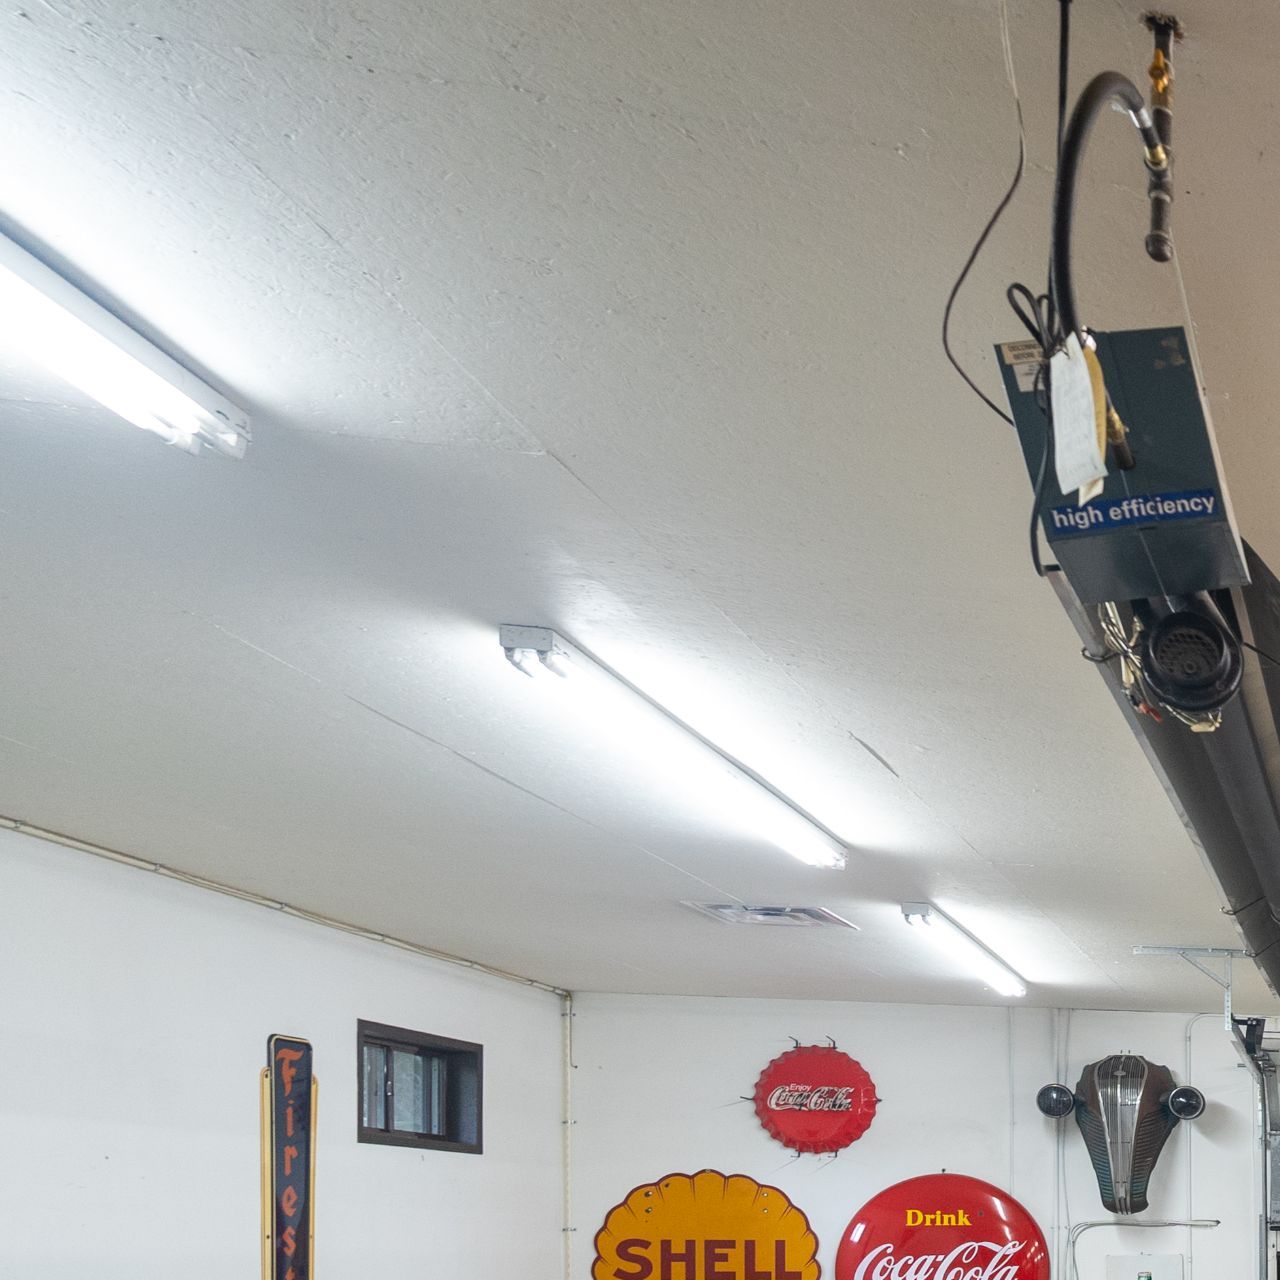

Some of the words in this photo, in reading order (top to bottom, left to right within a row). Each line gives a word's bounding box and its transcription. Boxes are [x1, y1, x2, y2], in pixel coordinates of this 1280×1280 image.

[1052, 505, 1103, 529] high
[1109, 496, 1215, 521] efficiency
[790, 1083, 812, 1092] Enjoy
[905, 1208, 973, 1228] Drink
